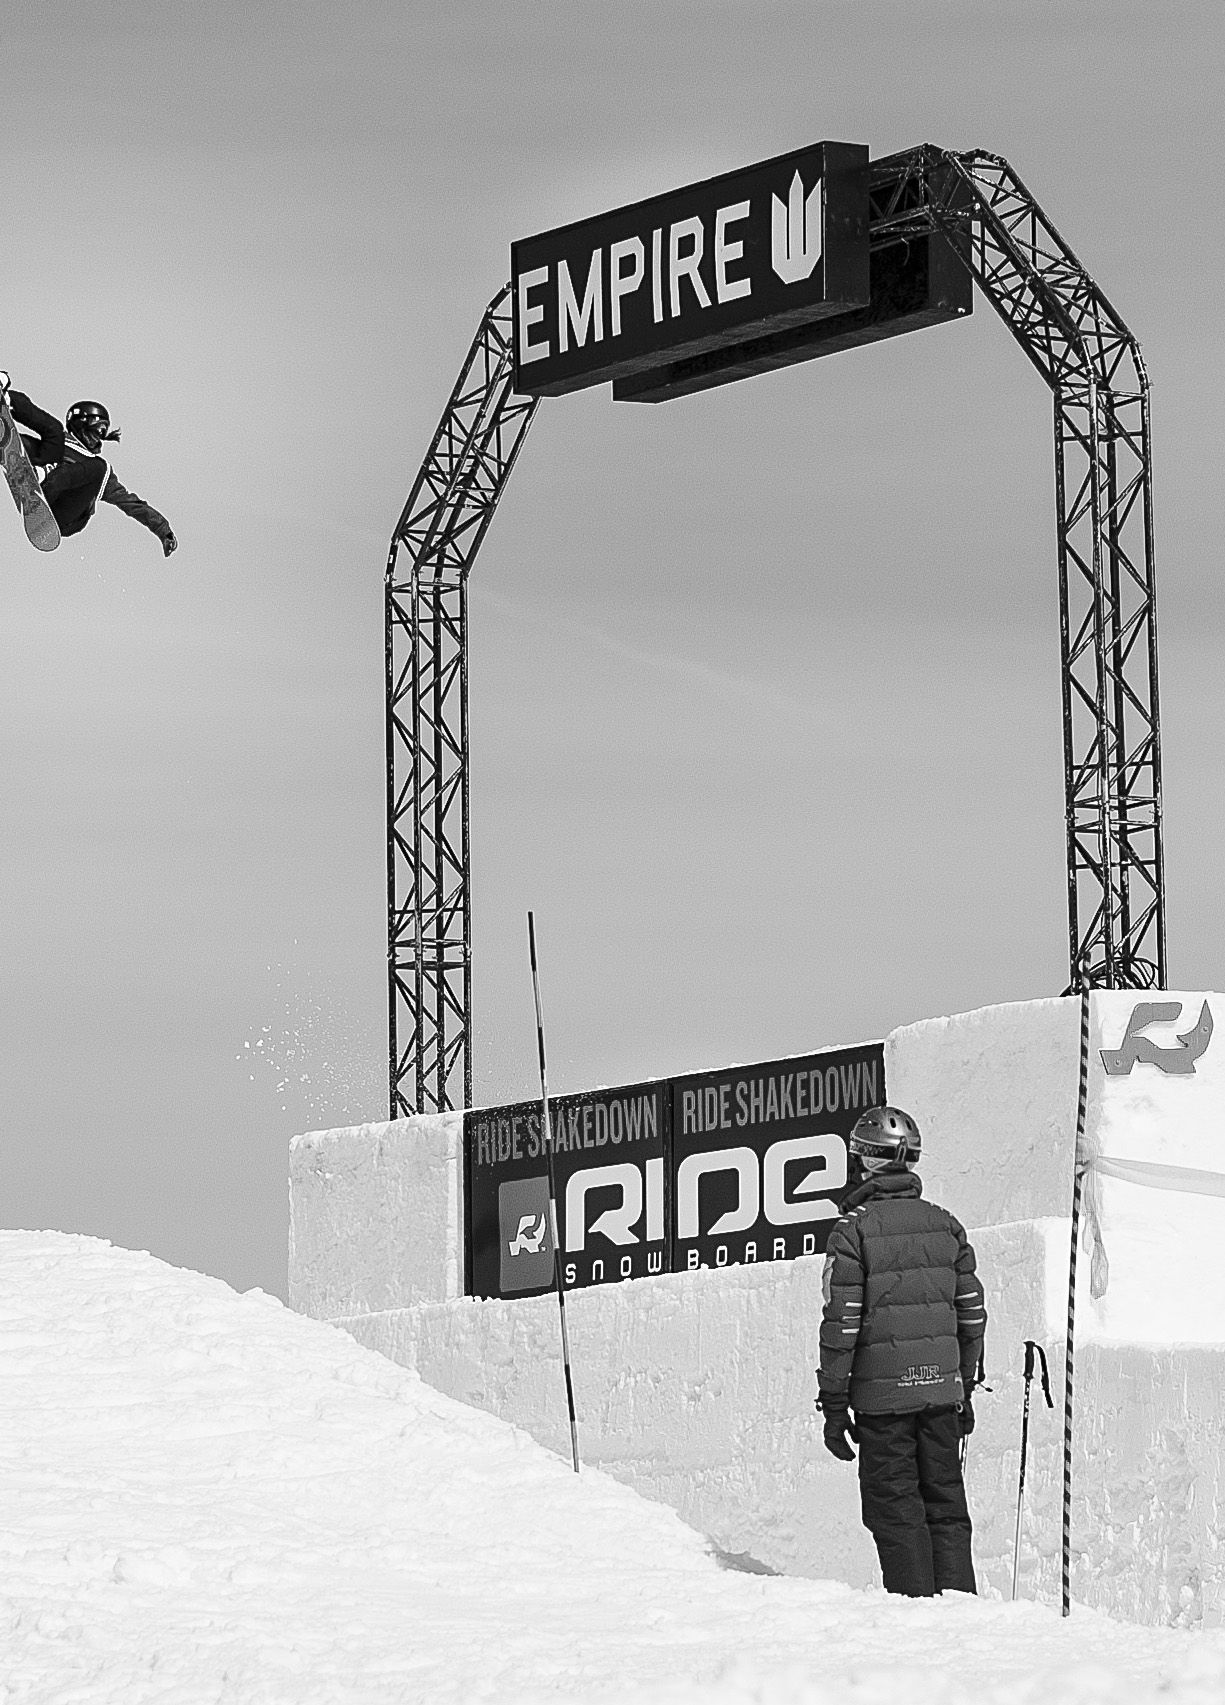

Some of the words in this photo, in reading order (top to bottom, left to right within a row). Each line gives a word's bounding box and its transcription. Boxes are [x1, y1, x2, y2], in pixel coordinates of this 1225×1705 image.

[518, 199, 752, 365] EMPIRE
[478, 1117, 523, 1166] RIDE
[527, 1093, 658, 1158] SHAKEDOWN
[682, 1083, 732, 1135] RIDE
[735, 1060, 877, 1127] SHAKEDOWN
[565, 1133, 848, 1253] RIDE
